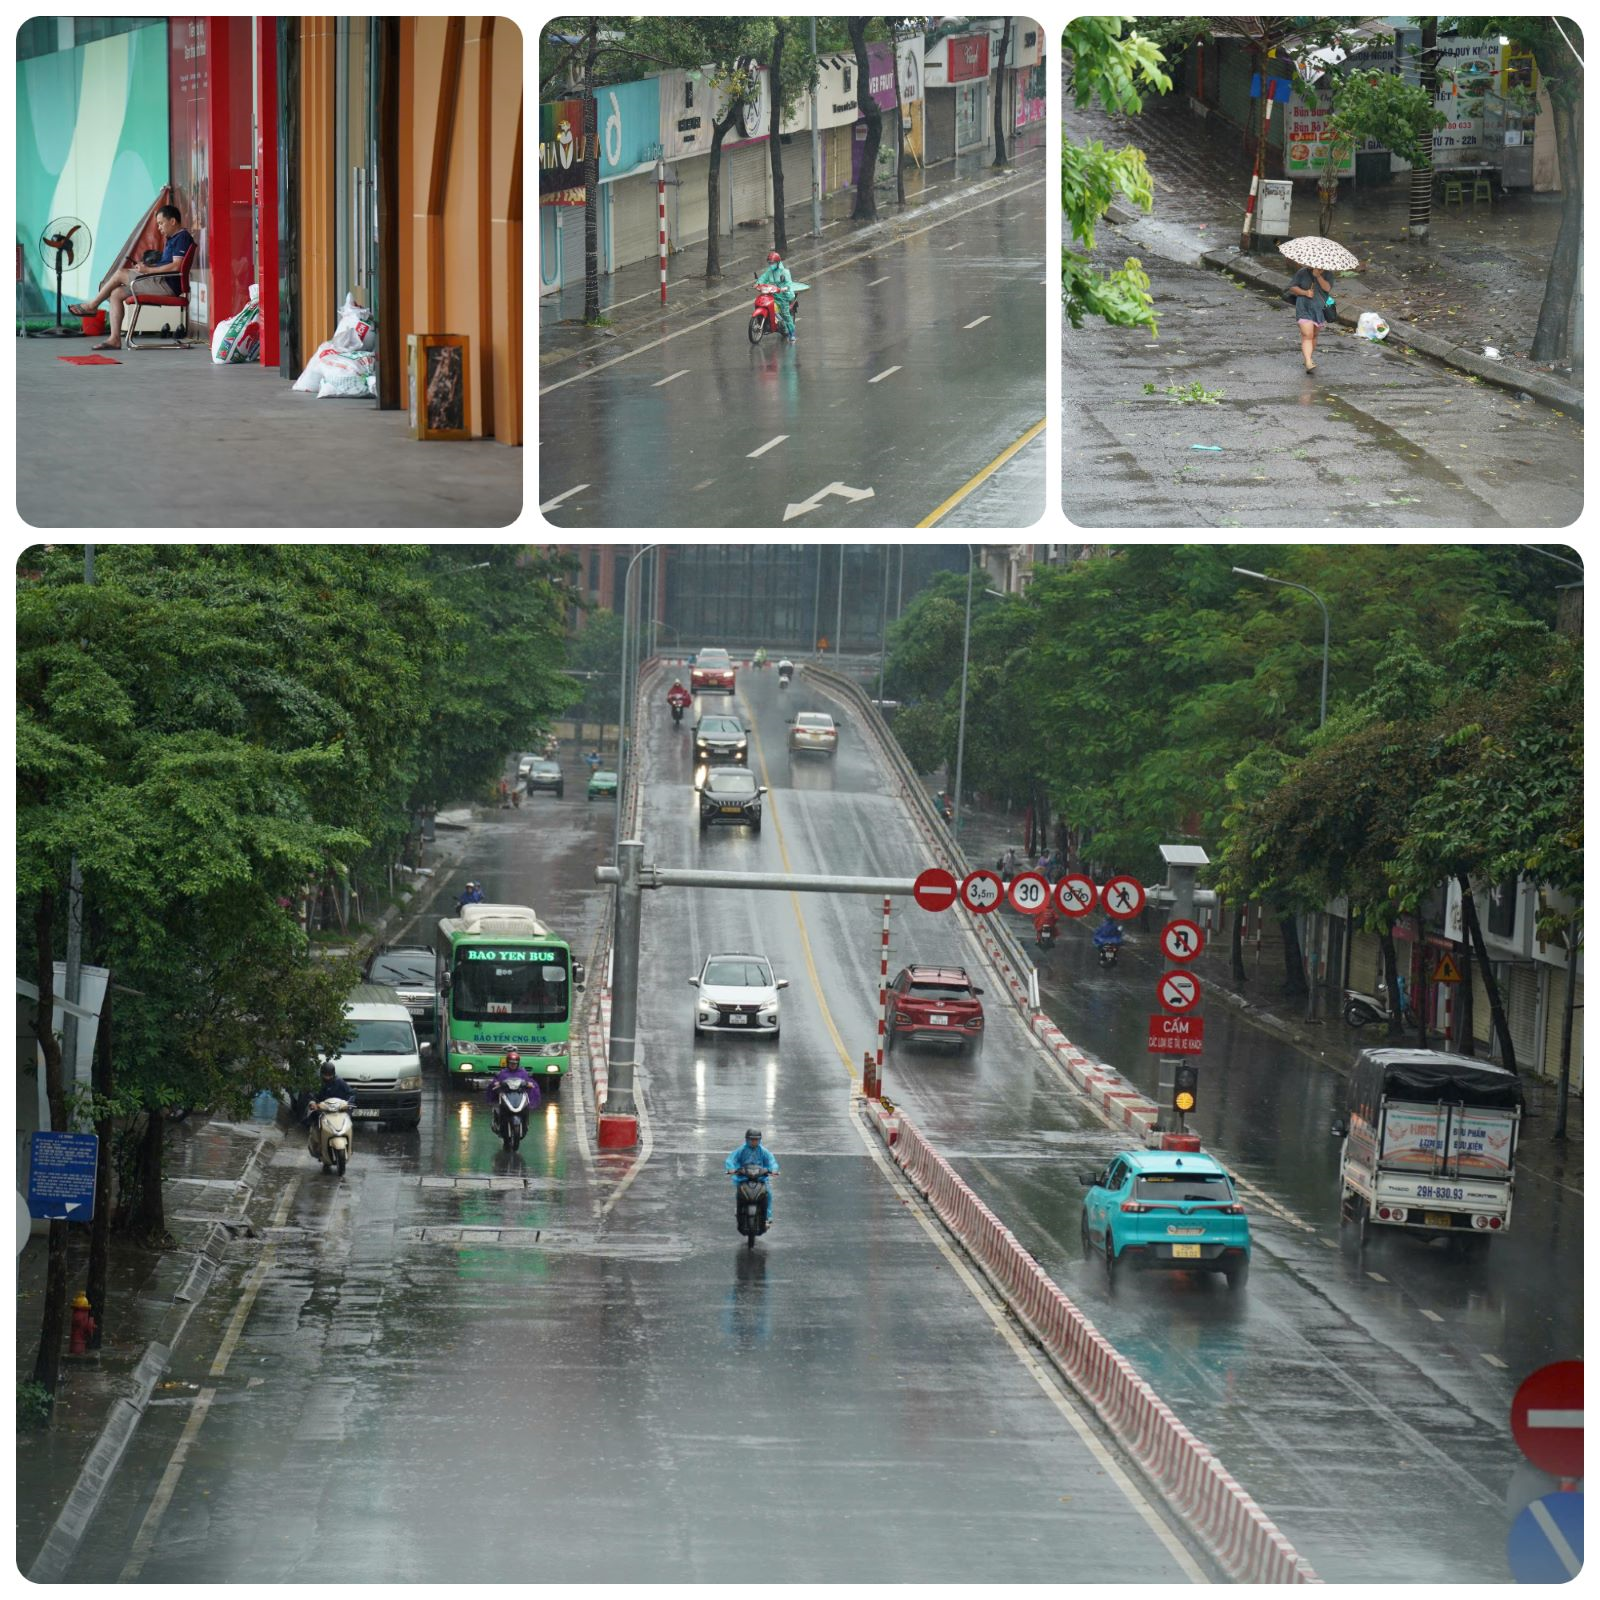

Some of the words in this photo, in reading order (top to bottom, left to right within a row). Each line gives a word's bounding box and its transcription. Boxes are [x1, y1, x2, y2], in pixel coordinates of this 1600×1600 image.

[879, 73, 893, 92] FRUIT
[970, 884, 995, 899] 3,5m
[1020, 884, 1039, 902] 30
[468, 950, 495, 960] BAO
[499, 951, 526, 961] YEN
[529, 952, 554, 961] BUS
[1163, 1016, 1189, 1034] CẤM
[1417, 1185, 1463, 1200] 29H-830.93
